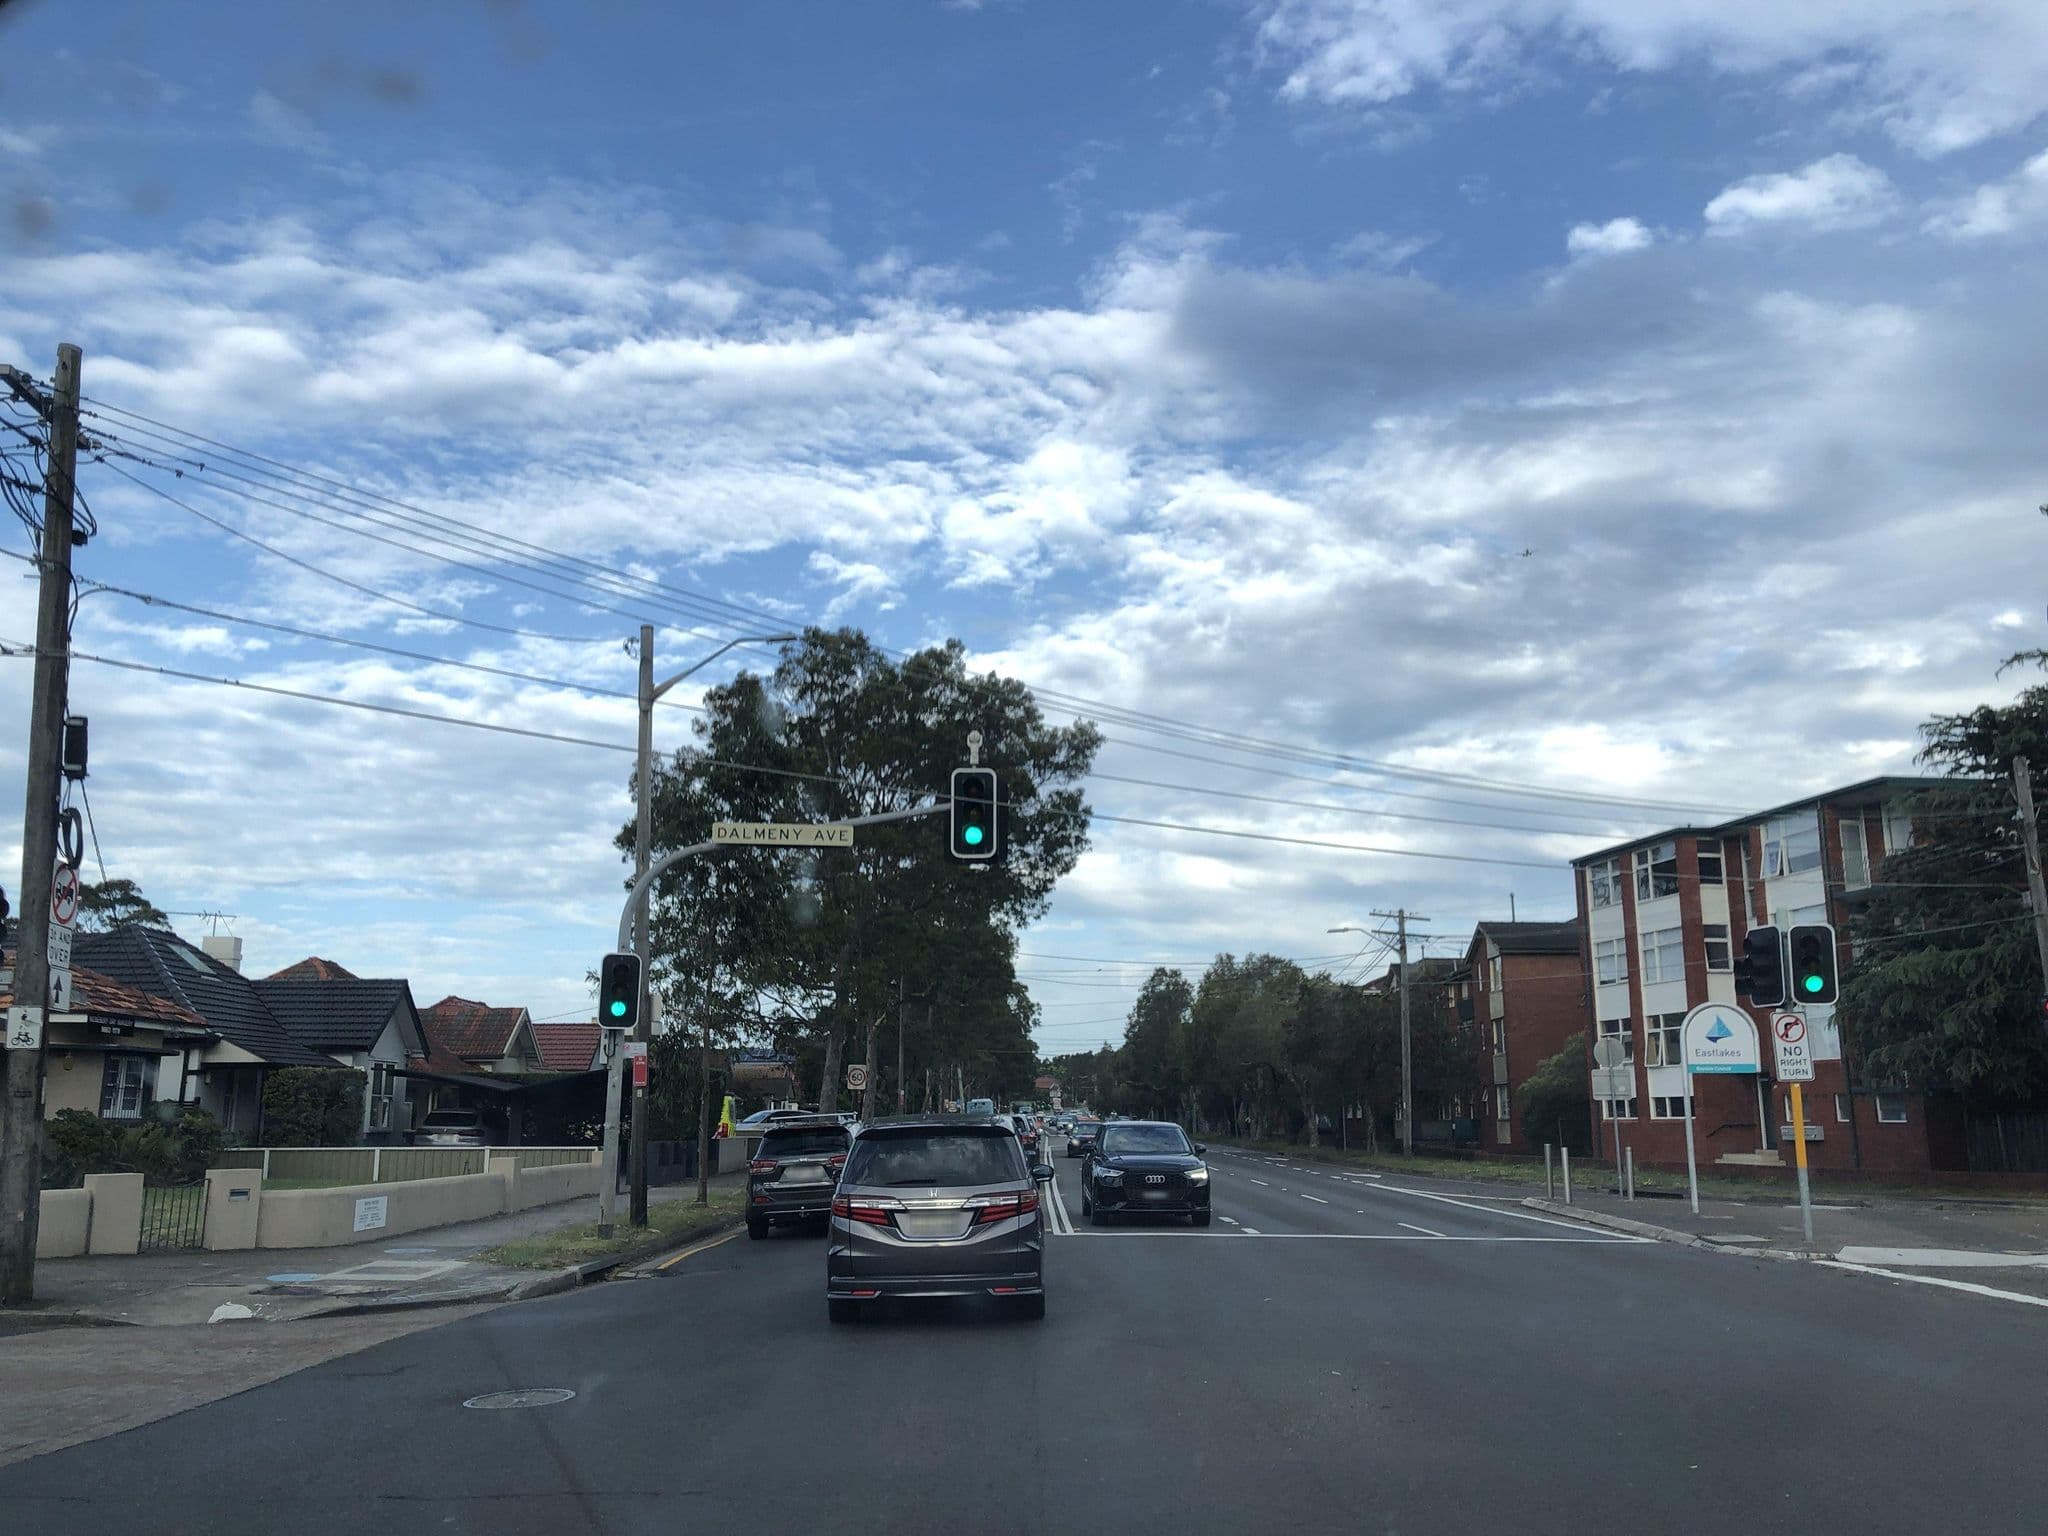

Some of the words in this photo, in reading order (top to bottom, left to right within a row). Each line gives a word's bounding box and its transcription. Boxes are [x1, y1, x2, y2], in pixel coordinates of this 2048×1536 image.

[717, 827, 803, 840] DALMENY
[814, 830, 849, 841] AVE
[50, 945, 69, 962] OVER
[1695, 1049, 1743, 1057] Eastlakes
[1783, 1046, 1803, 1056] NO
[1780, 1059, 1807, 1067] RIGHT
[1782, 1067, 1809, 1076] TURN
[851, 1072, 863, 1082] 60
